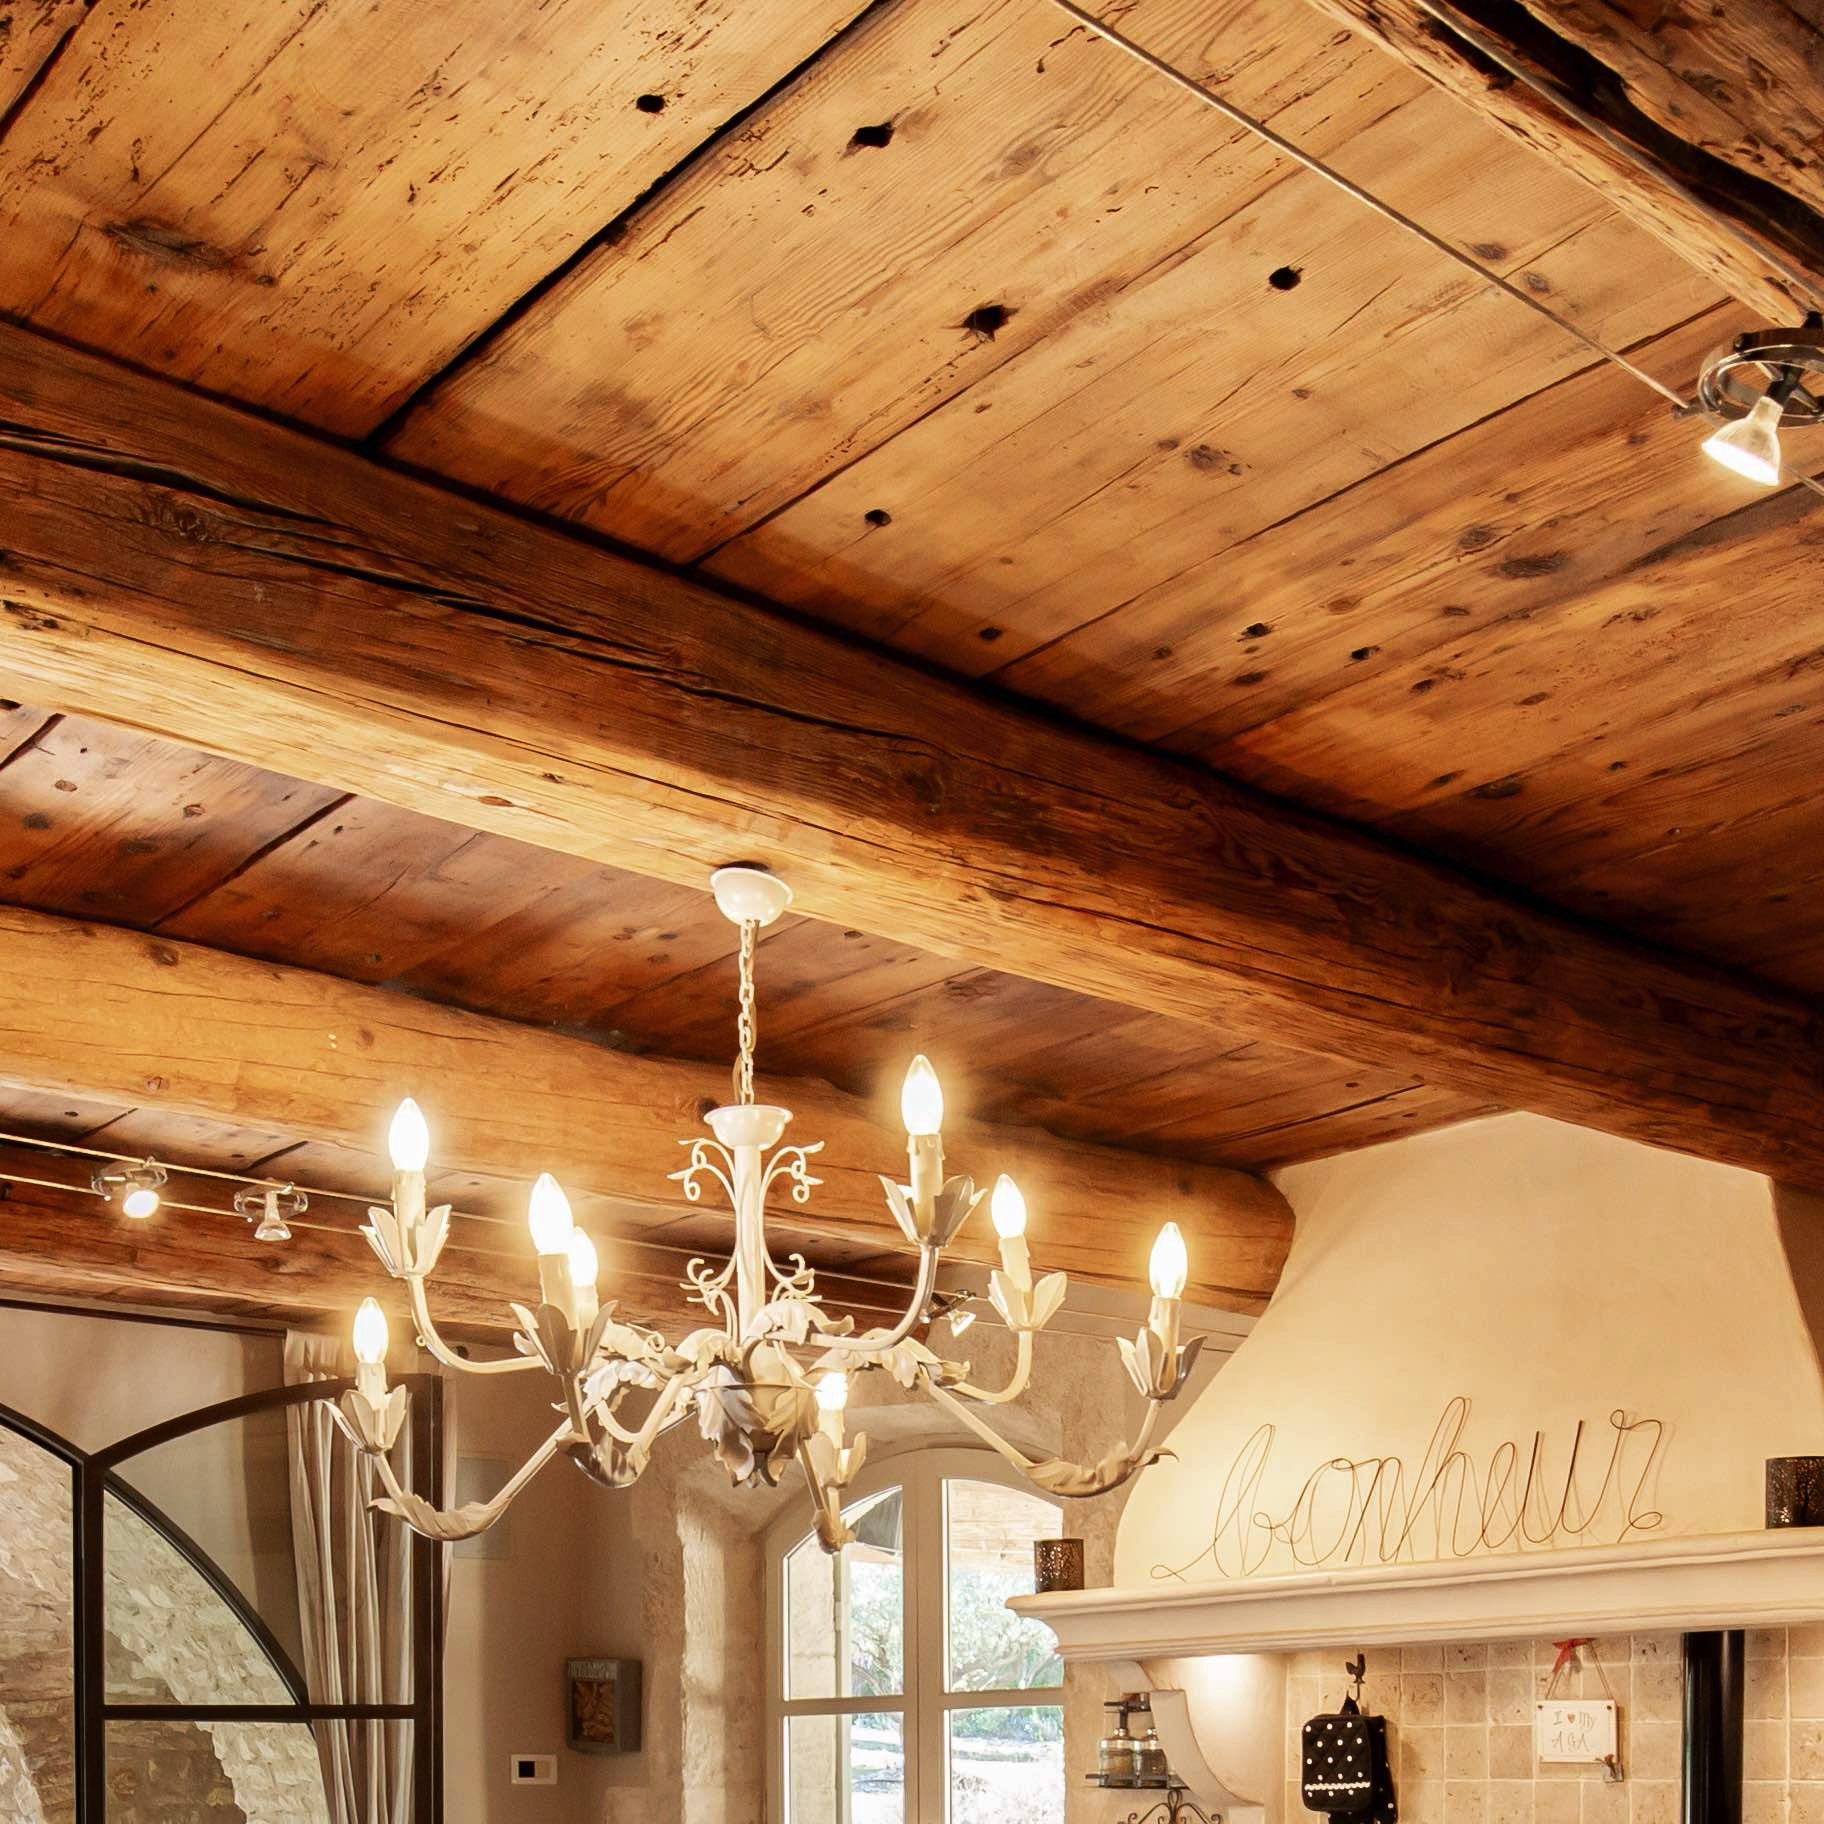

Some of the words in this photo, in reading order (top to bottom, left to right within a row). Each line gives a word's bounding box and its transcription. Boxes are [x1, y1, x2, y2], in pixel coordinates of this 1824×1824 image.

[1150, 1396, 1663, 1582] bonheur
[1553, 1709, 1563, 1726] I
[1551, 1730, 1590, 1753] AGA
